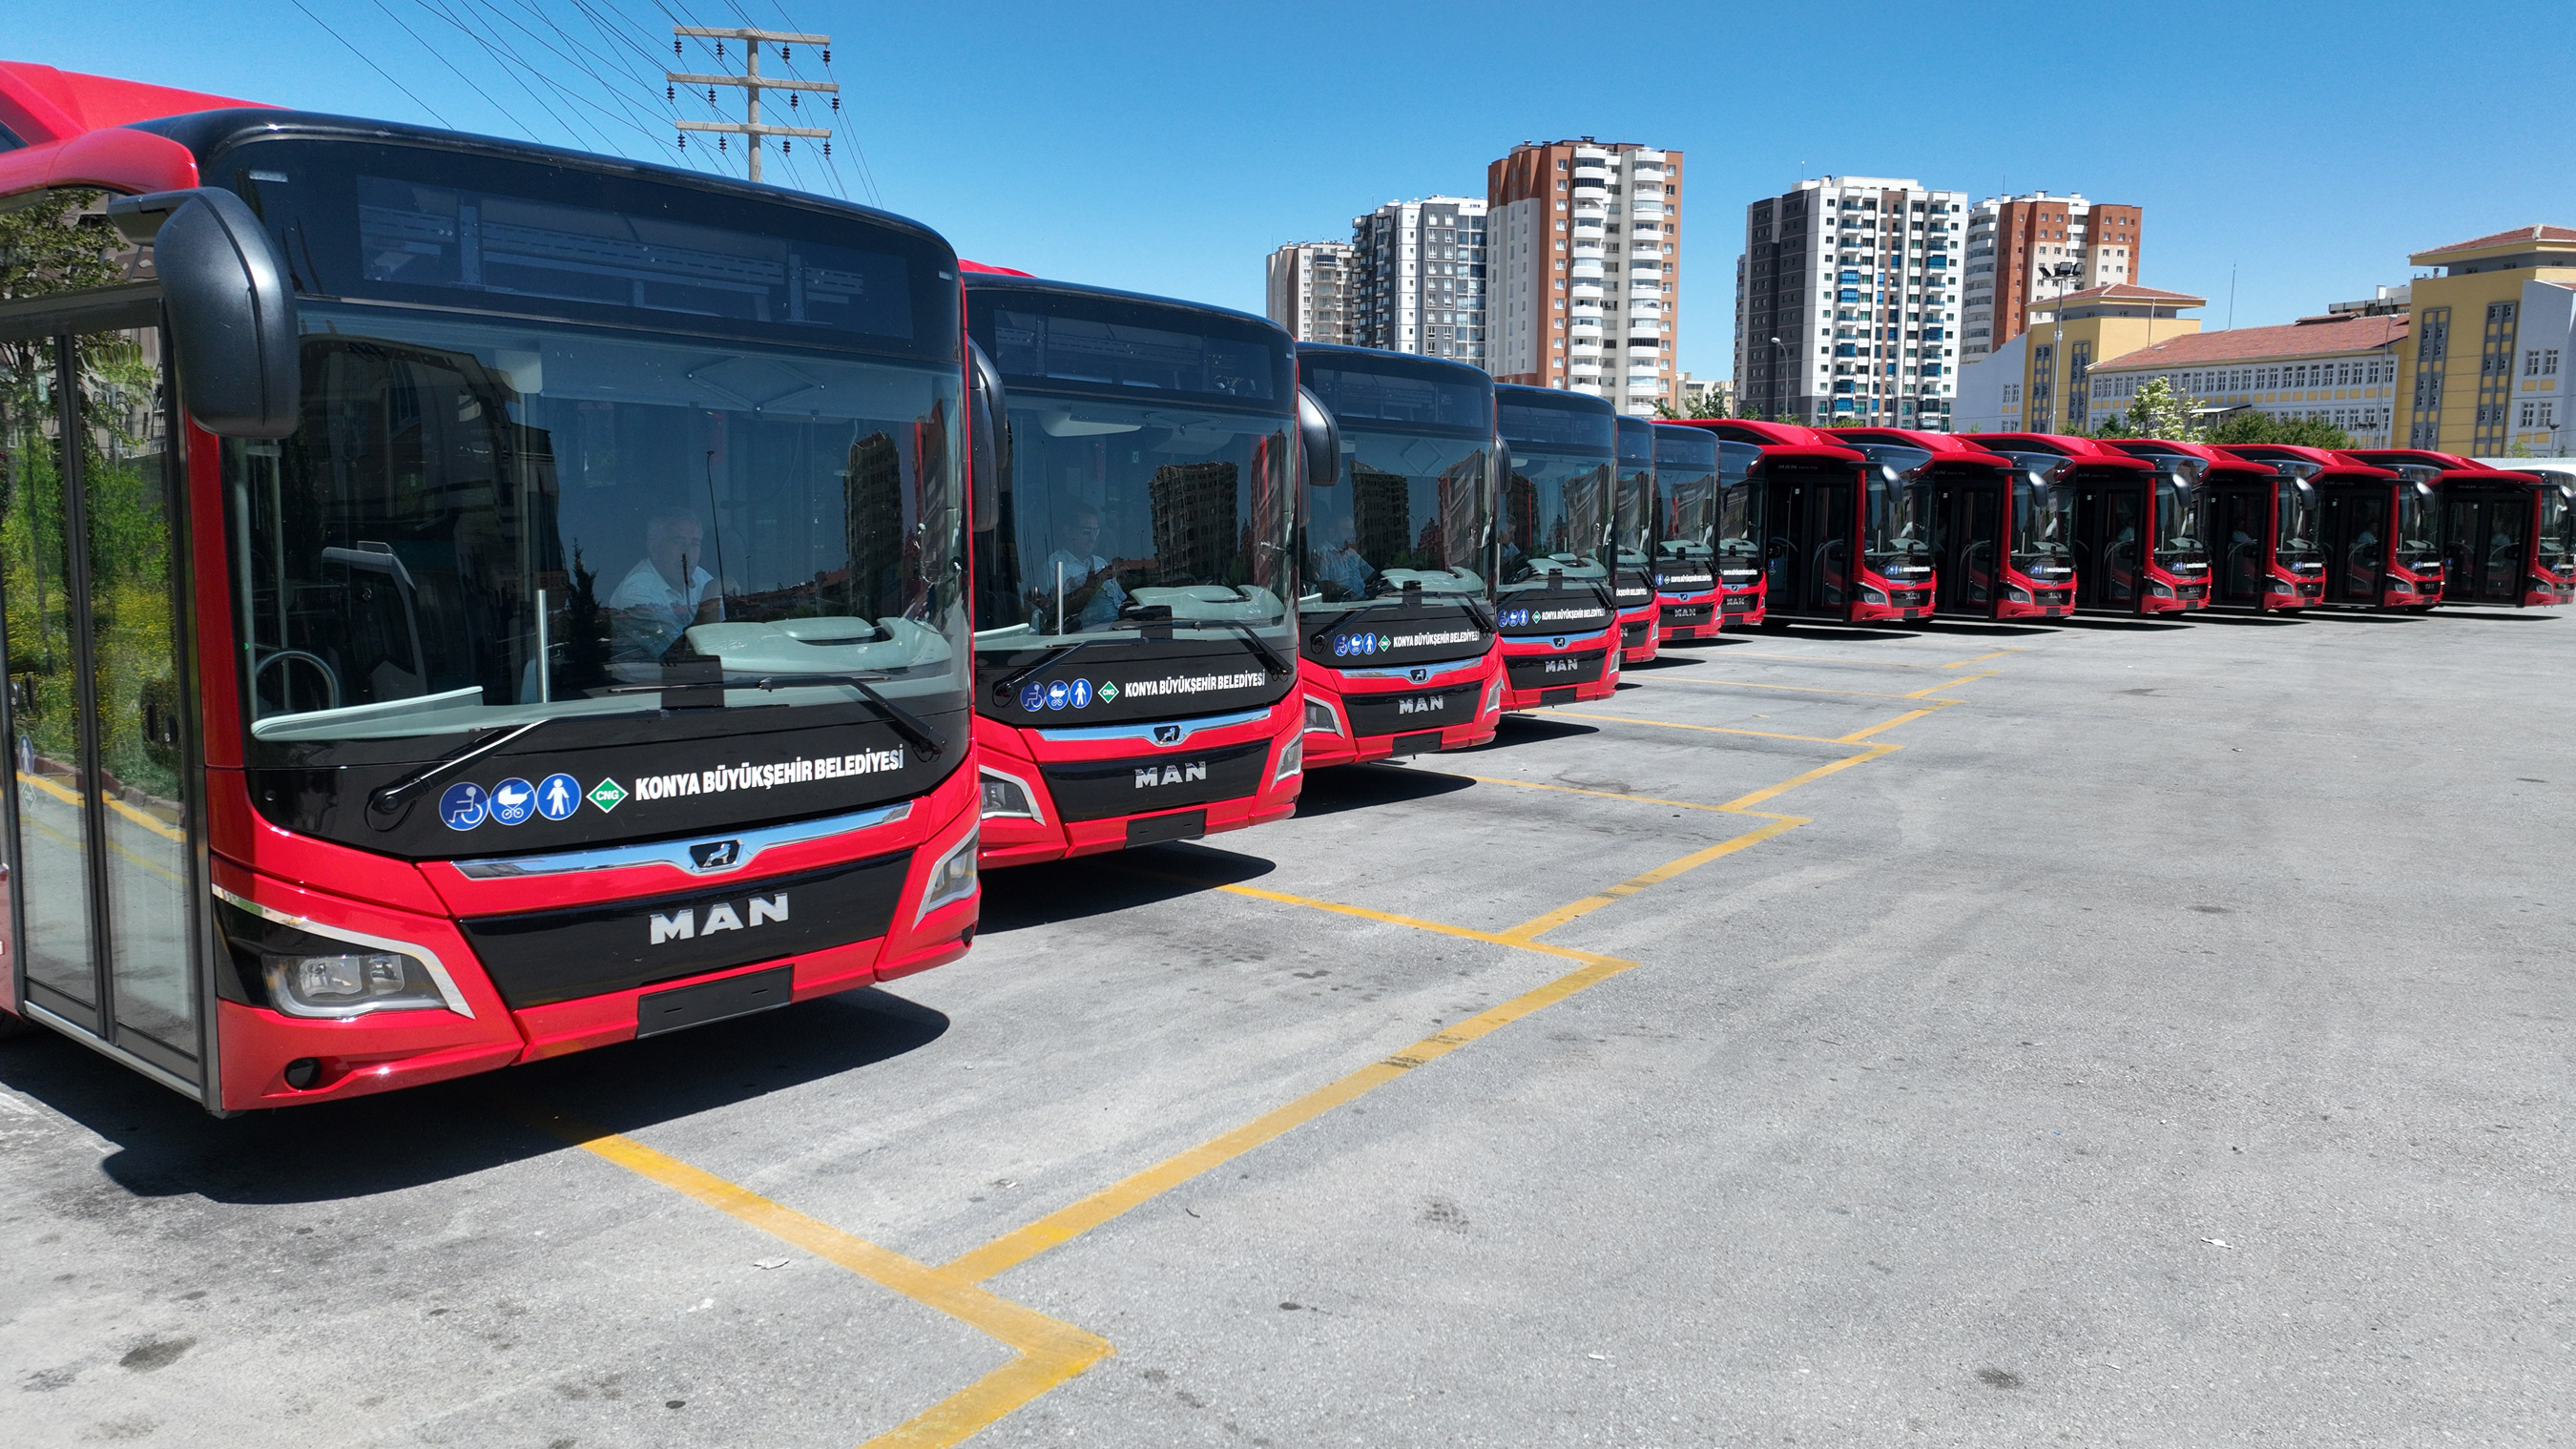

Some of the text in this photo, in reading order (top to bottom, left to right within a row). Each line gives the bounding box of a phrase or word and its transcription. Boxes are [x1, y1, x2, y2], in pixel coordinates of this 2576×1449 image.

[1674, 609, 1696, 617] MAN
[1393, 628, 1480, 648] KONYA BÜYÜKŞEHİR BELEDİYESİ
[1545, 658, 1578, 673] MAN
[1125, 669, 1265, 697] KONYA BÜYÜKŞEHİR BELEDİYESİ
[1399, 695, 1444, 714] MAN
[635, 744, 904, 801] KONYA BÜYÜKŞEHİR BELEDİYESİ
[1134, 761, 1207, 789] MAN
[595, 790, 619, 801] CNG
[650, 893, 788, 945] MAN
